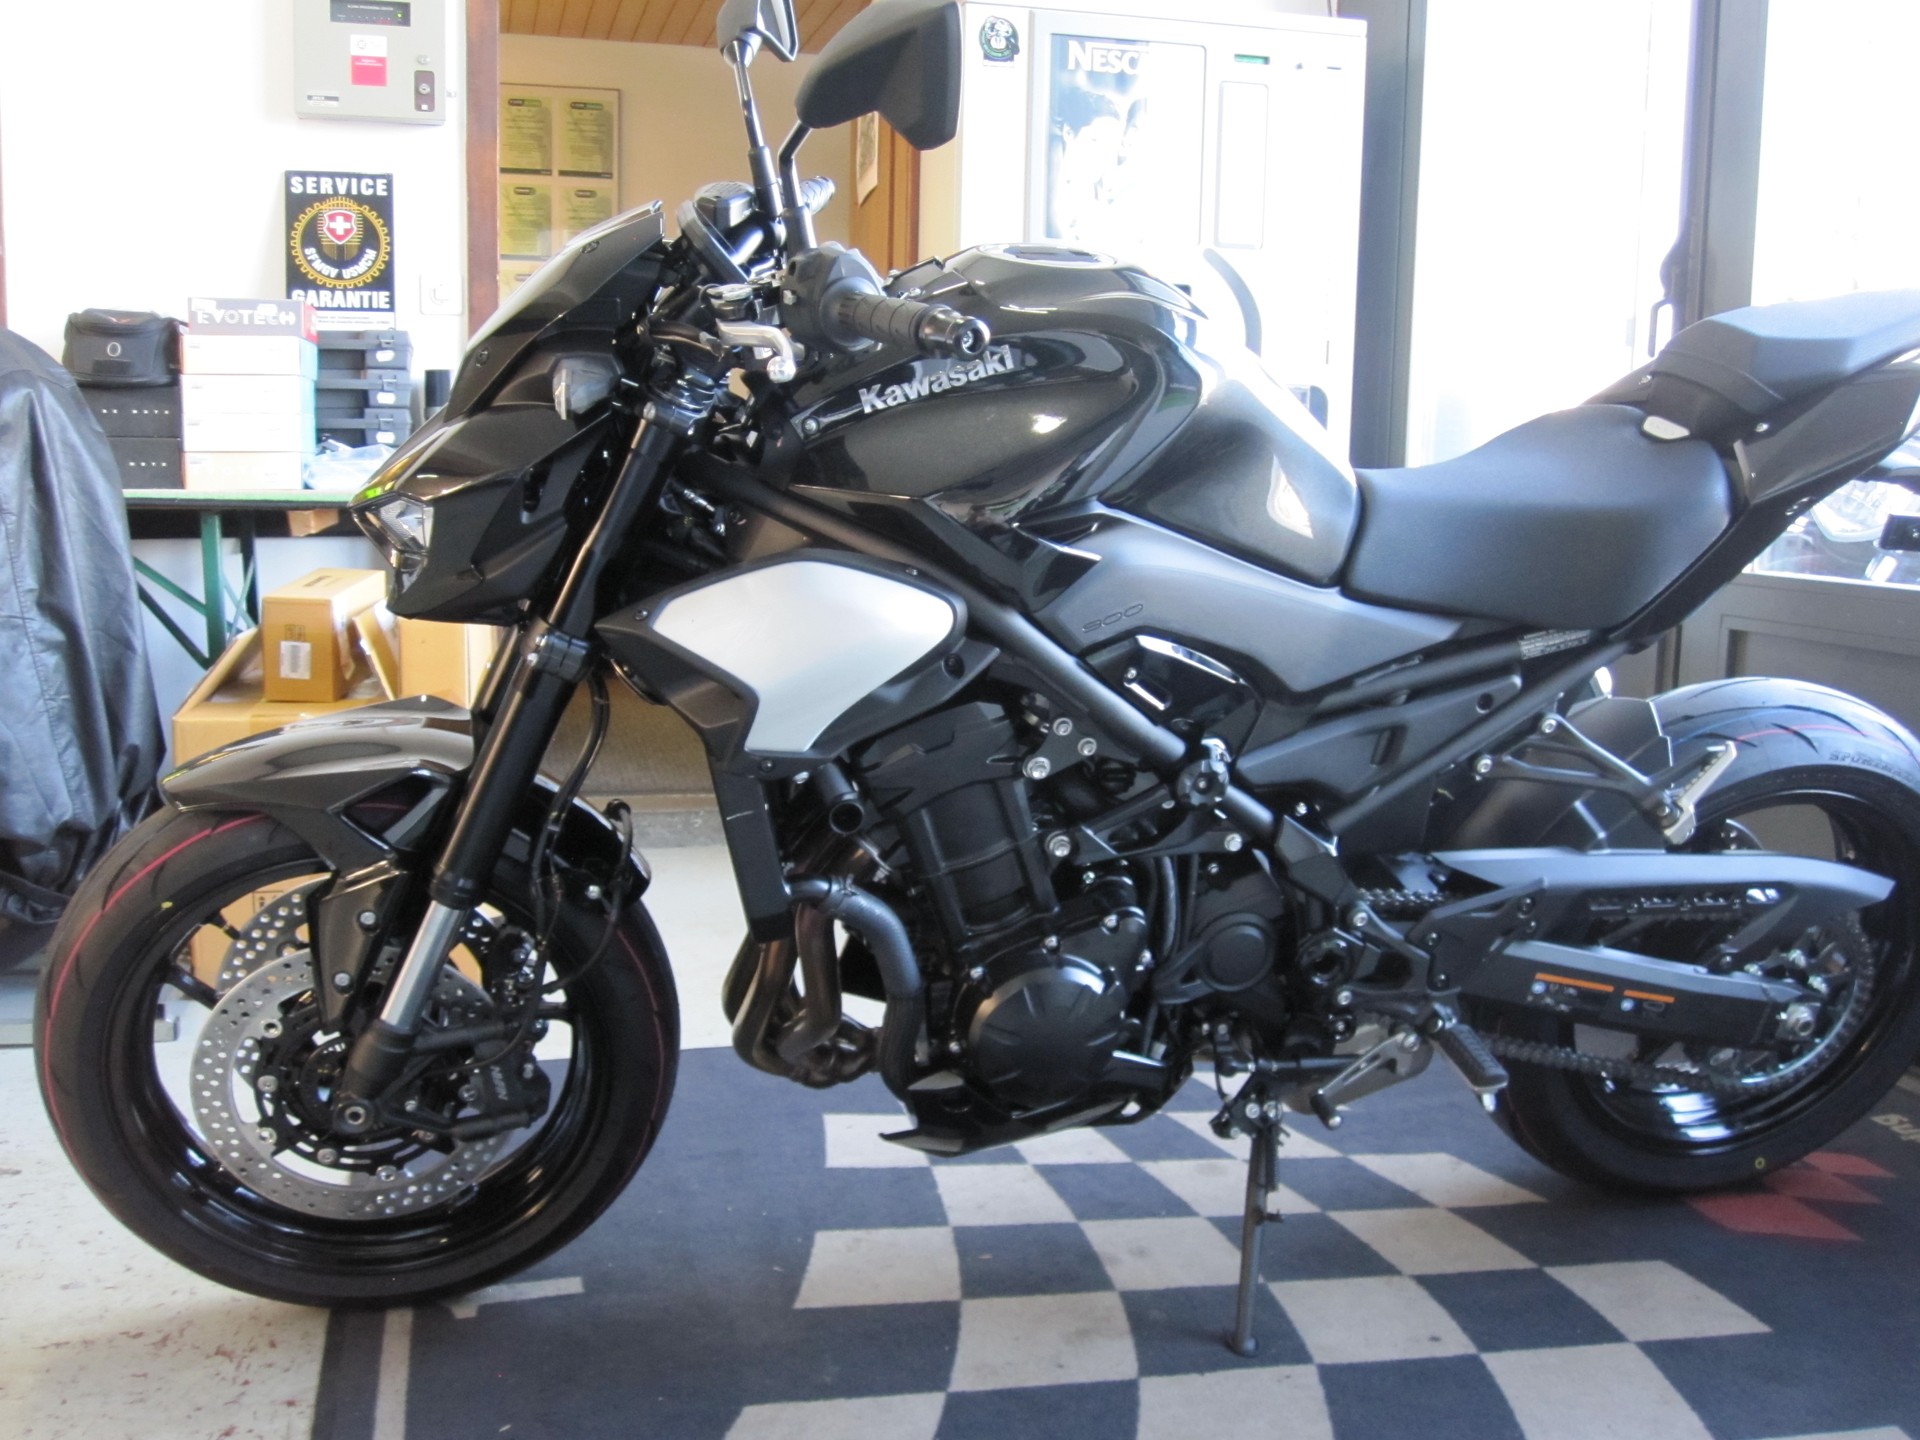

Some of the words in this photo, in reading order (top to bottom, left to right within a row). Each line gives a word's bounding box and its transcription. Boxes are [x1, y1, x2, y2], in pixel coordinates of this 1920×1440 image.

[290, 176, 388, 196] SERVICE
[291, 289, 391, 309] GARANTIE
[858, 344, 1014, 414] Kawasaki
